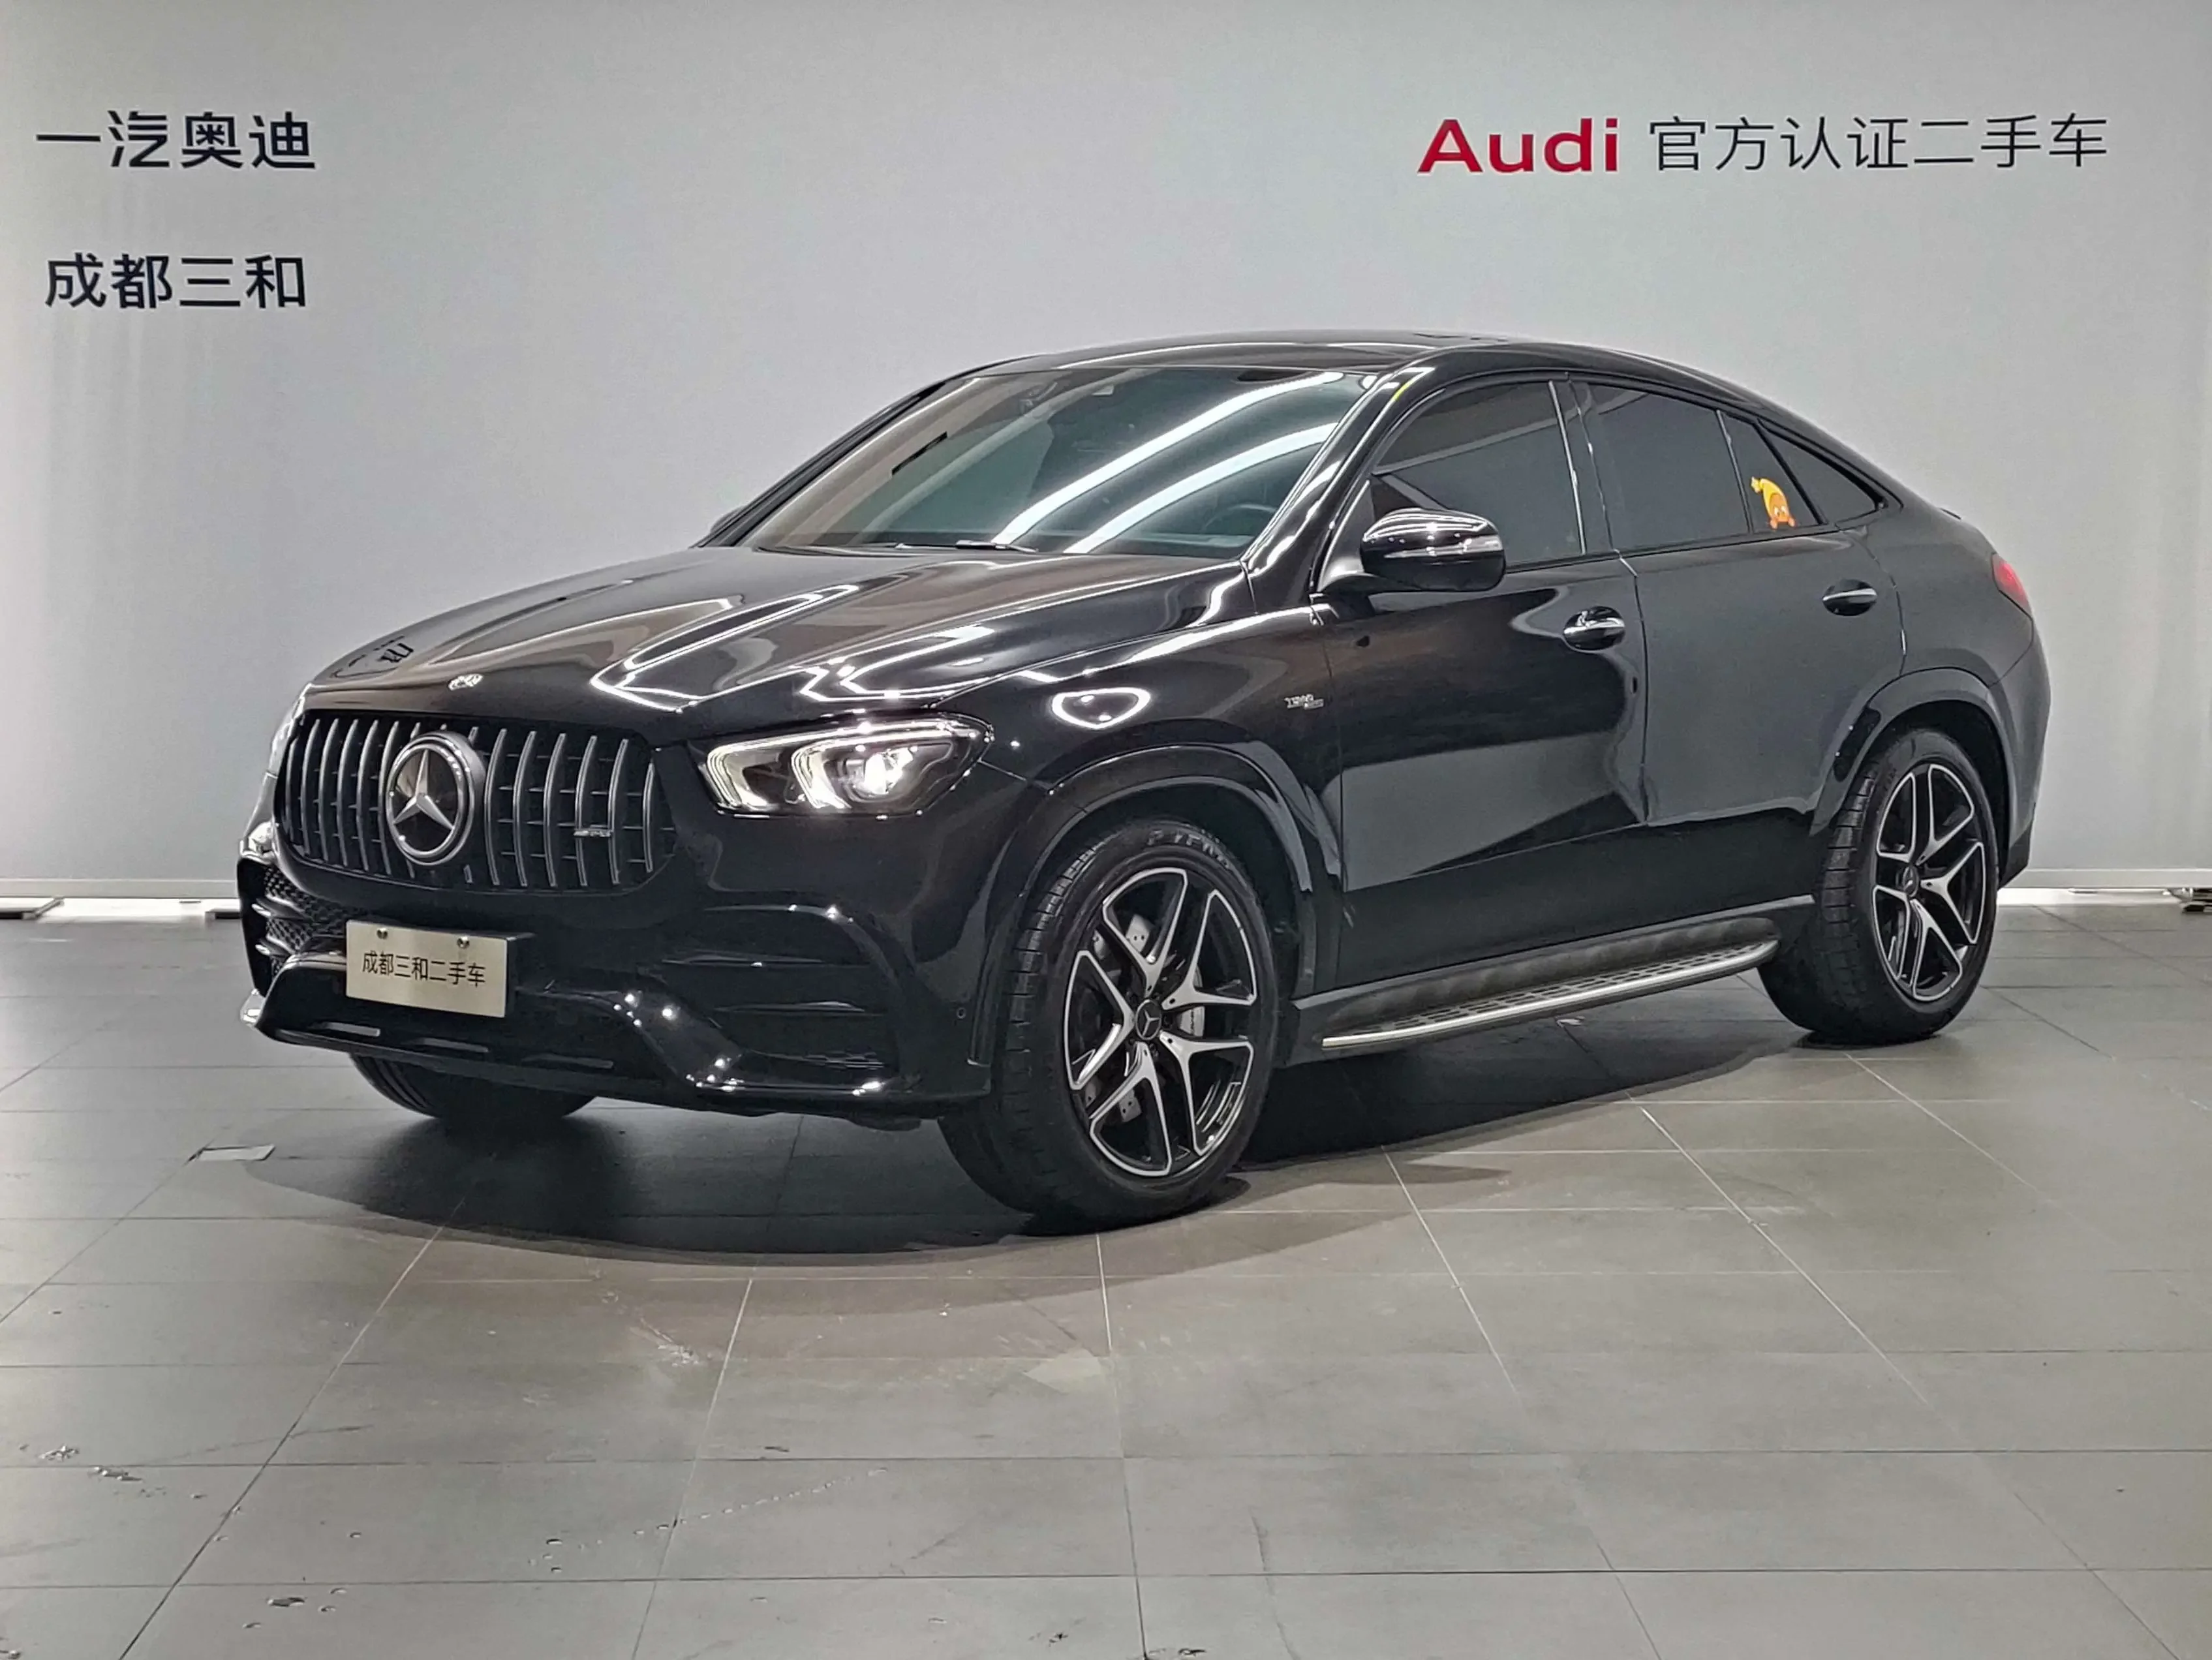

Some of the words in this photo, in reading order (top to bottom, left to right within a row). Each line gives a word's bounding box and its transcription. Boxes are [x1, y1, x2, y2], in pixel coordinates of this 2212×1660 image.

[36, 110, 316, 169] 一汽奥迪
[1419, 118, 1618, 173] Audi
[1649, 112, 2108, 171] 官方认证二手车
[45, 253, 306, 309] 成都三和
[361, 950, 487, 987] 成都三和二手车
